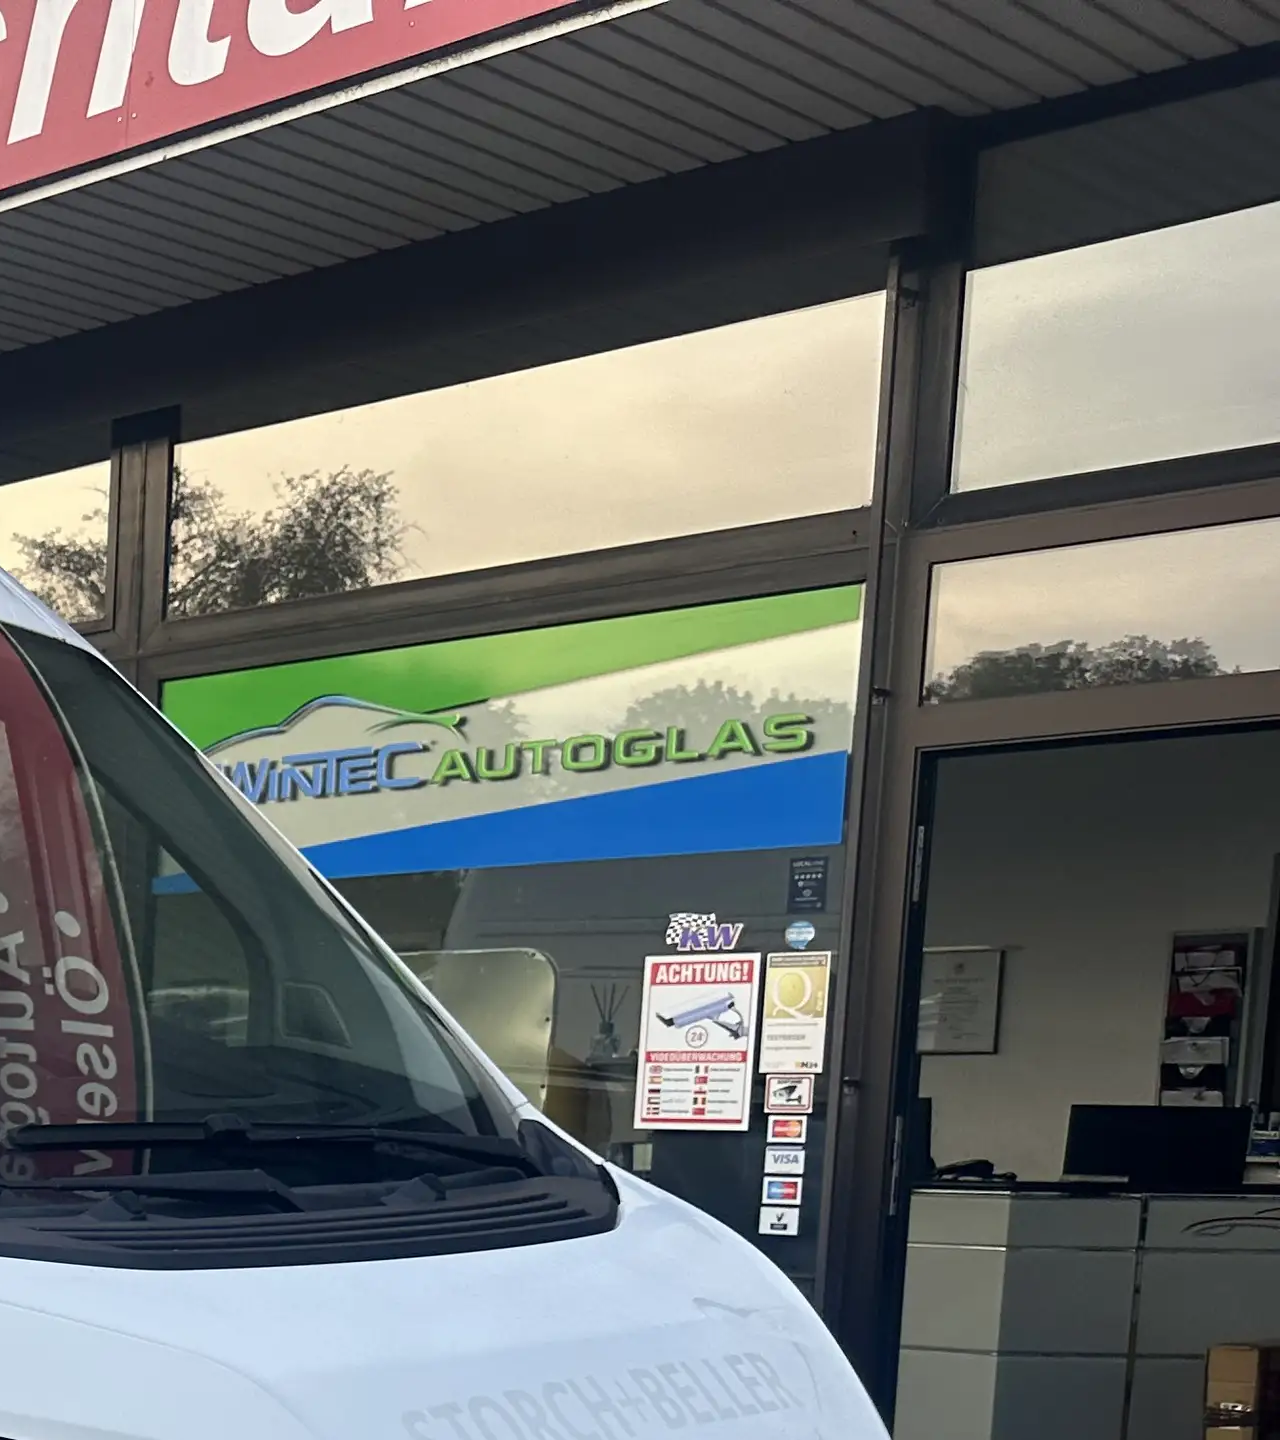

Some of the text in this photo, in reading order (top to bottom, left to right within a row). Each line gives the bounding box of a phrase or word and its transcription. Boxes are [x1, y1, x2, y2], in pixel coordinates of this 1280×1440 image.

[430, 712, 819, 788] AUTOGLAS
[679, 924, 742, 950] KW
[655, 962, 749, 984] ACHTUNG!
[772, 1154, 799, 1165] VISA
